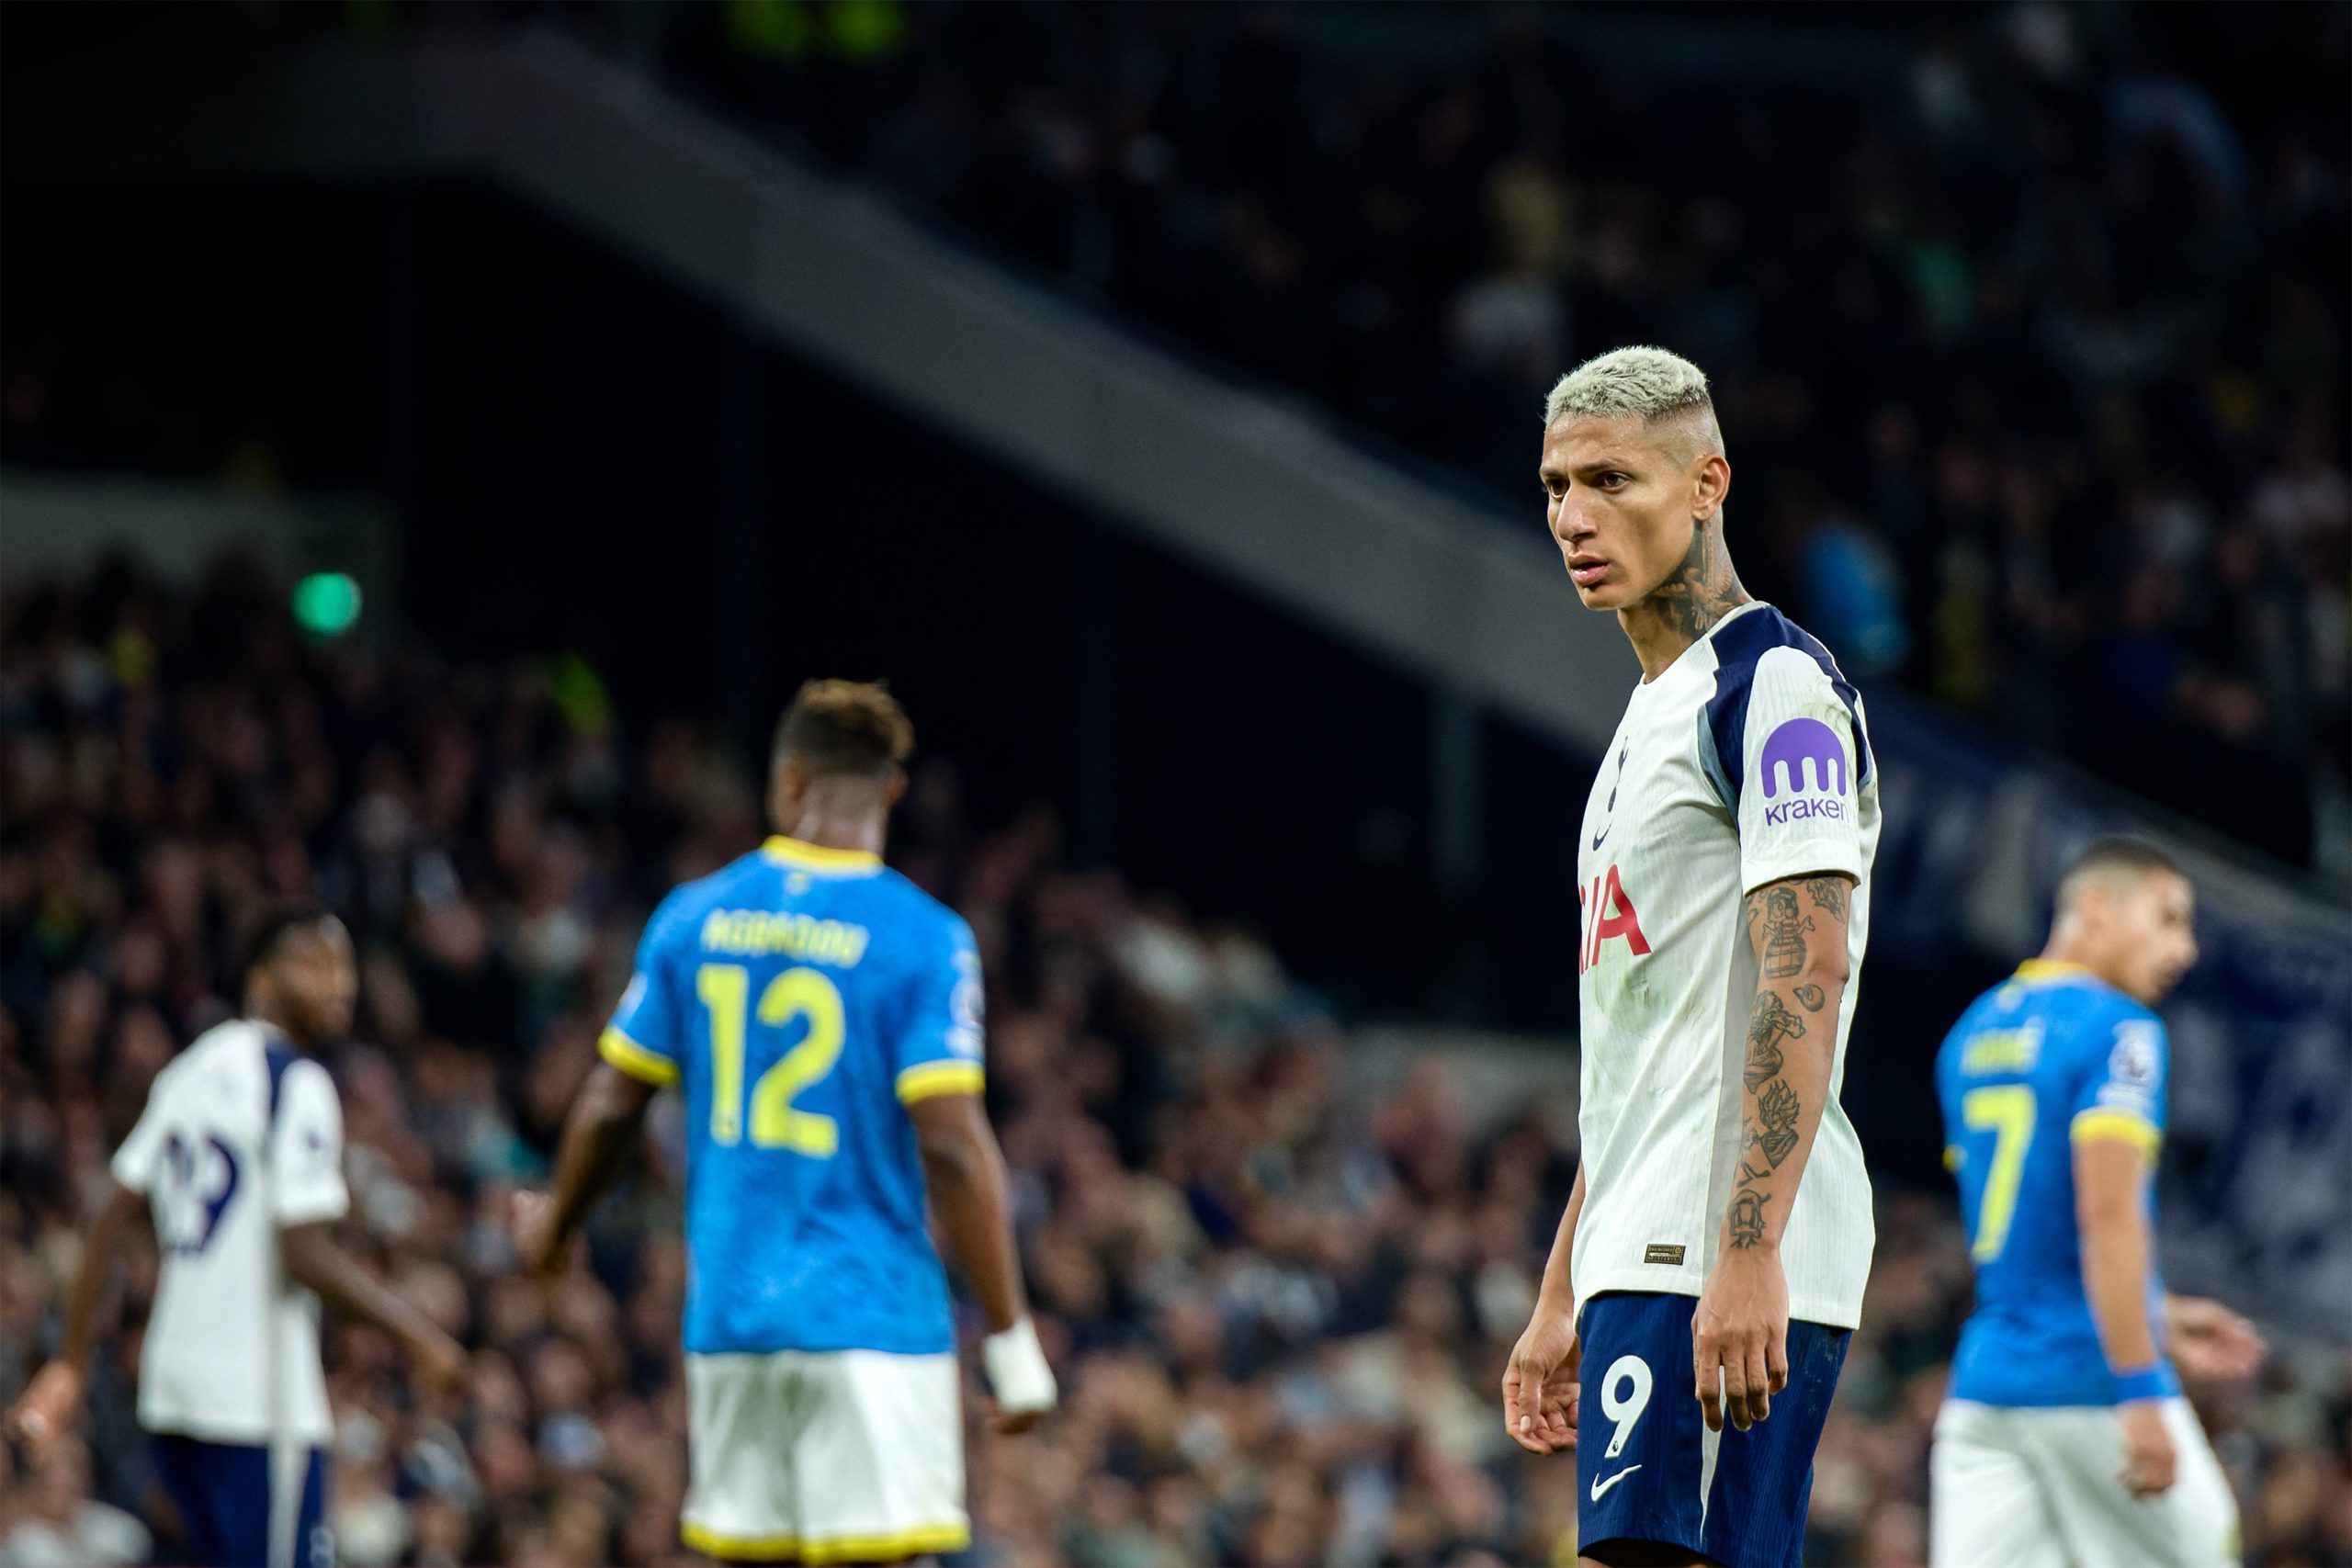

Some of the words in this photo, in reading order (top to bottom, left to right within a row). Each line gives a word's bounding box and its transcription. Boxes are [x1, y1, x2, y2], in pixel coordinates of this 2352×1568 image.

[1578, 863, 1653, 976] IA
[696, 963, 846, 1159] 12
[1962, 1083, 2037, 1265] 7
[1601, 1355, 1653, 1459] 9
